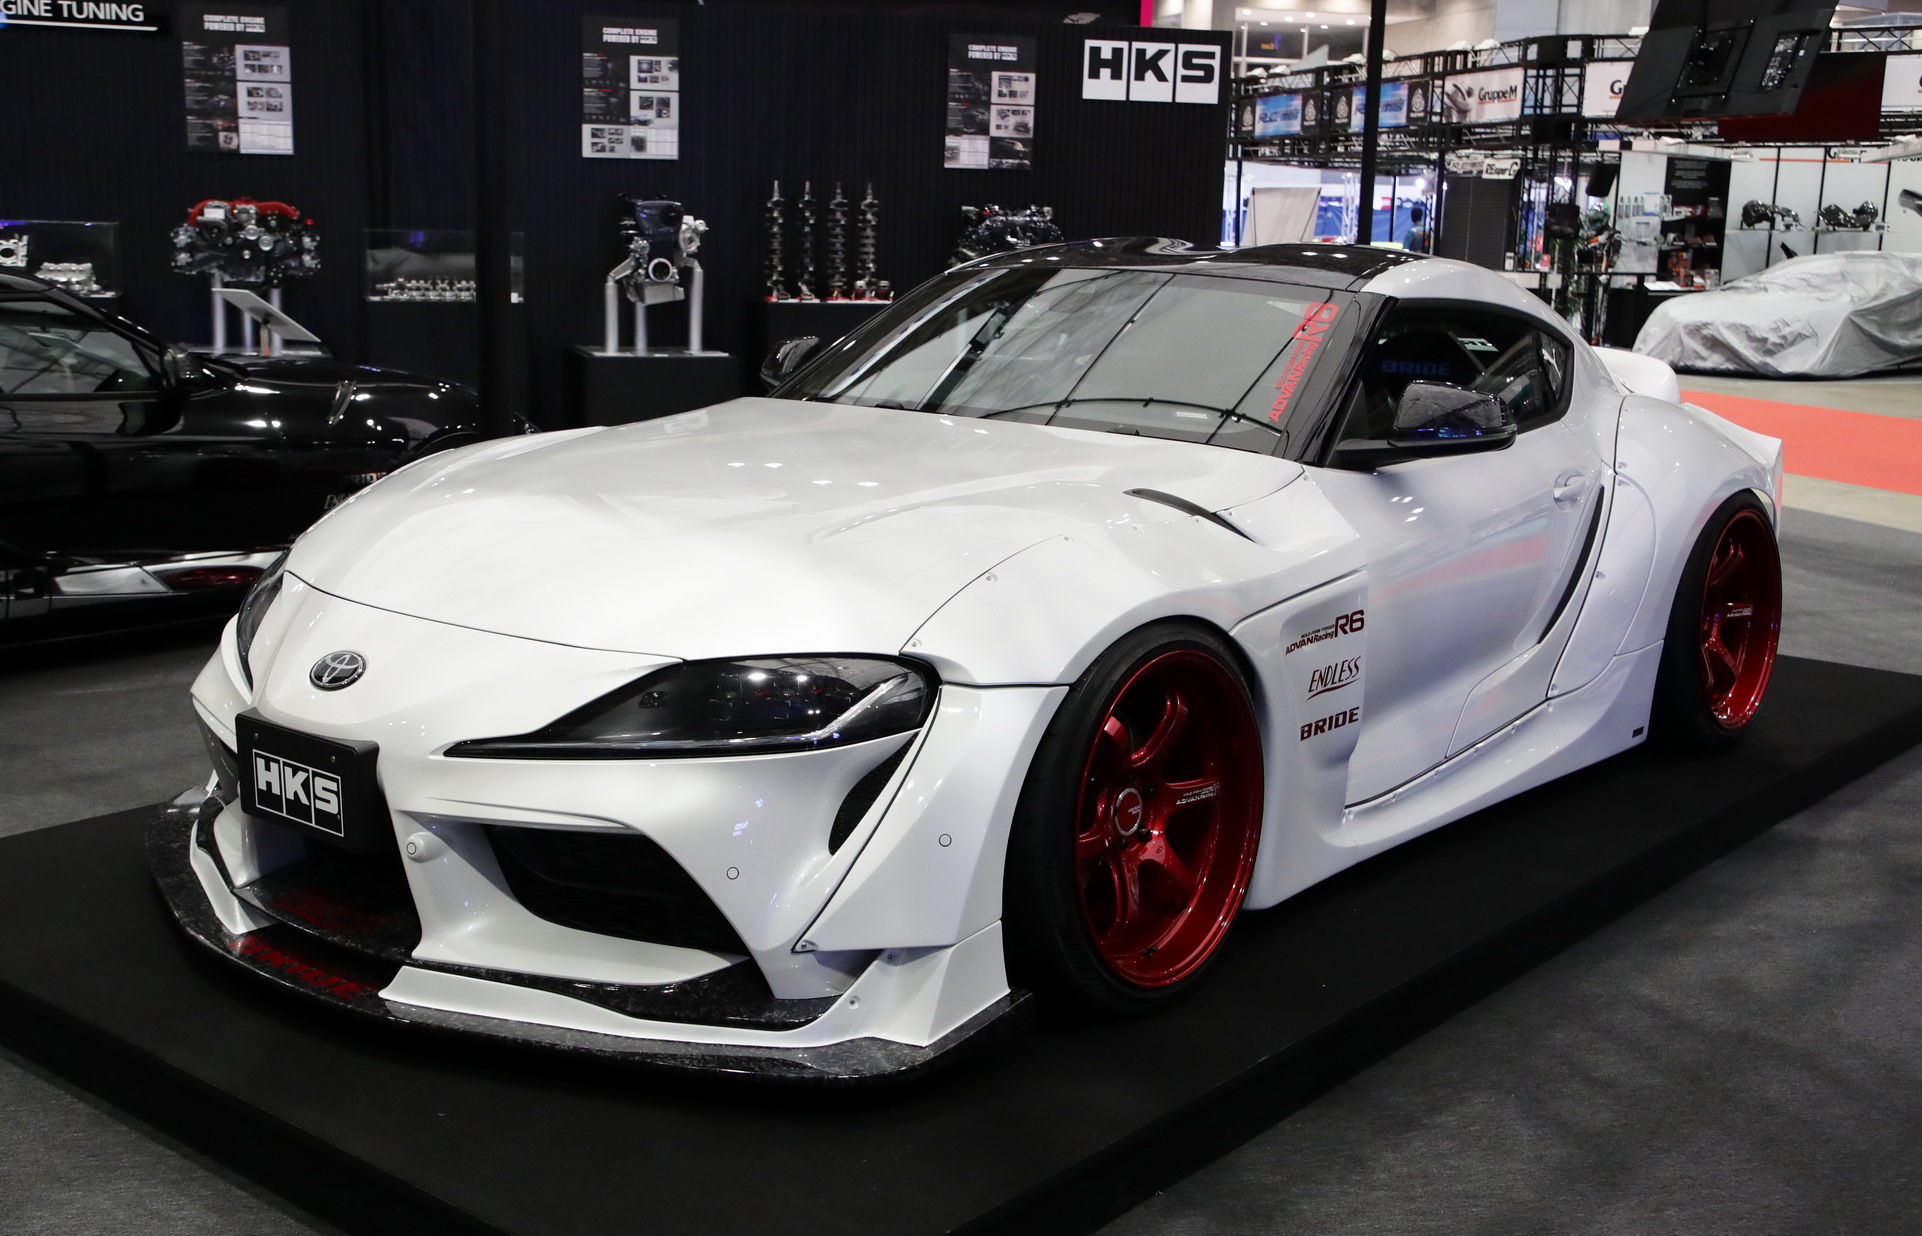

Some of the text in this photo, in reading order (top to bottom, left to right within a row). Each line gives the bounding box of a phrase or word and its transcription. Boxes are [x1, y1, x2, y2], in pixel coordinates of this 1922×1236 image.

[57, 1, 145, 22] TUNING
[1087, 45, 1217, 84] HKS
[1478, 85, 1518, 103] GruppeM
[1381, 360, 1452, 376] BRIDE
[1335, 609, 1365, 637] R6
[1308, 656, 1362, 693] ENDLESS
[1300, 706, 1360, 741] BRIDE
[256, 756, 339, 815] HKS
